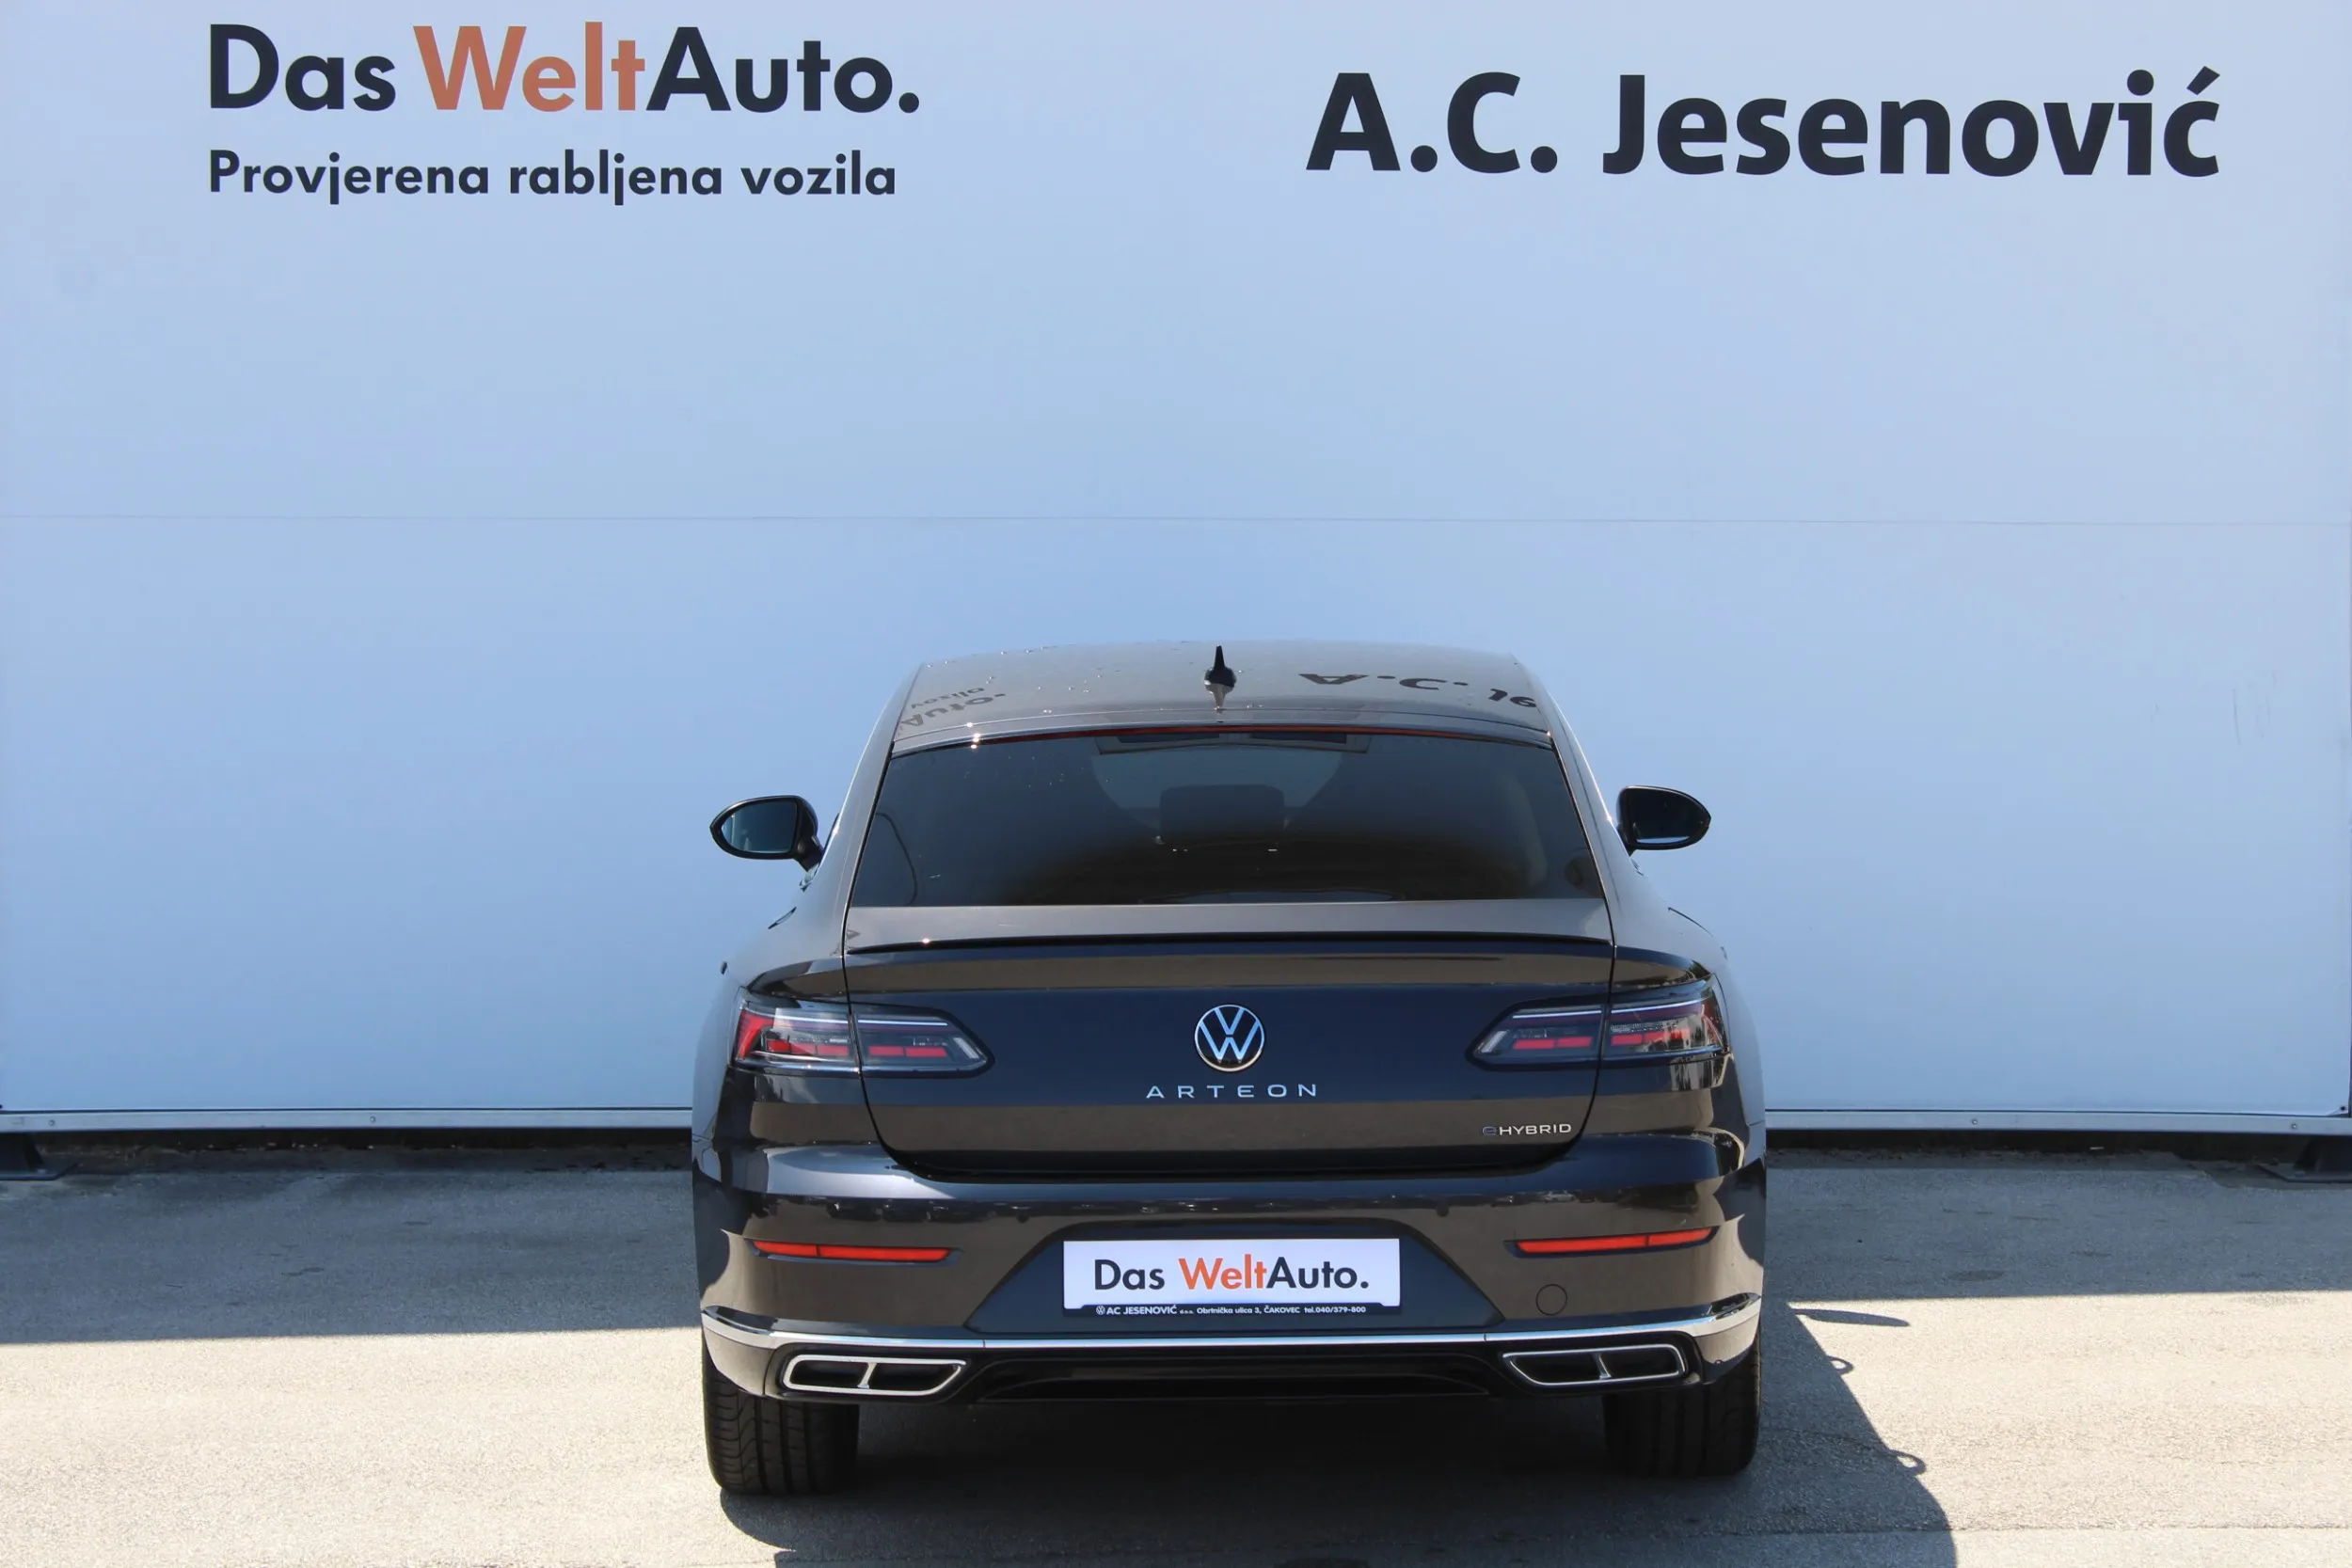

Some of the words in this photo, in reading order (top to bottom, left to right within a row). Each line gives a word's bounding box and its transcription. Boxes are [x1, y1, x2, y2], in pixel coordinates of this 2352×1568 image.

[209, 23, 396, 112] Das
[412, 21, 920, 114] WeltAuto.
[1305, 71, 1558, 174] A.C.
[1602, 65, 2221, 178] Jesenović
[210, 149, 489, 206] Provjerena
[509, 148, 723, 207] rabljena
[739, 149, 896, 197] vozila
[1145, 1083, 1317, 1100] ARTEON
[1482, 1123, 1572, 1136] eHYBRID
[1094, 1259, 1166, 1291] Das
[1178, 1253, 1370, 1291] WeltAuto.
[1106, 1307, 1121, 1315] AC
[1123, 1304, 1177, 1315] JESENOVIĆ
[1196, 1306, 1233, 1314] Obrtnička
[1234, 1306, 1253, 1314] ulica
[1263, 1305, 1300, 1314] ČAKOVEC
